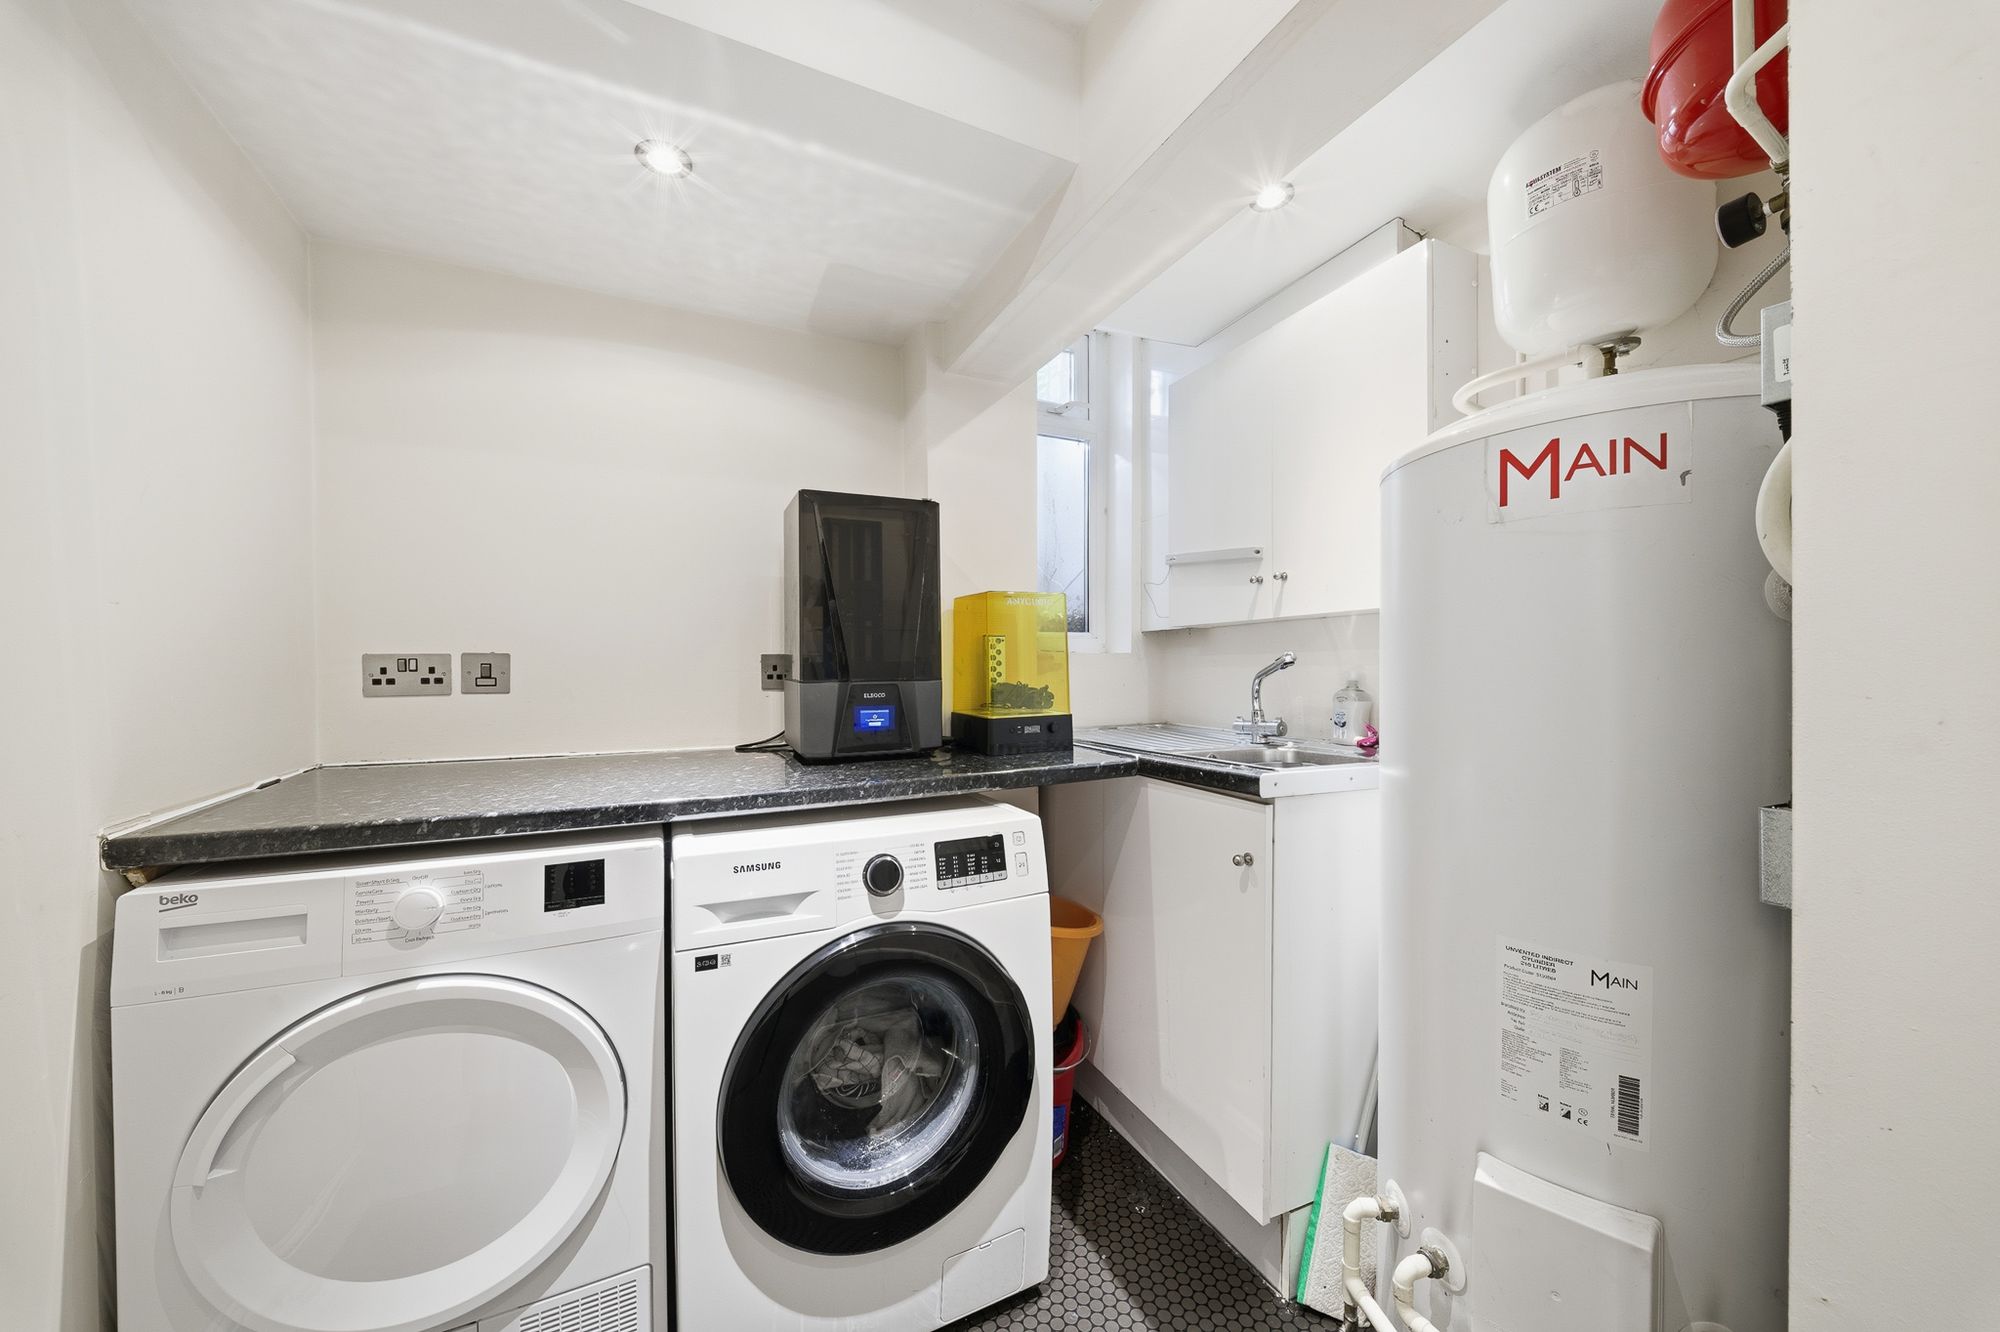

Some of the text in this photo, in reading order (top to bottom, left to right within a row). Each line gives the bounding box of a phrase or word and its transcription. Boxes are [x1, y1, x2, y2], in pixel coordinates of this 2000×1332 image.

[1499, 433, 1668, 508] MAIN
[733, 861, 781, 874] SAMSUNG
[159, 893, 198, 906] beko
[1505, 945, 1574, 966] UNVENTED INDIRECT
[1591, 969, 1638, 990] MAIN
